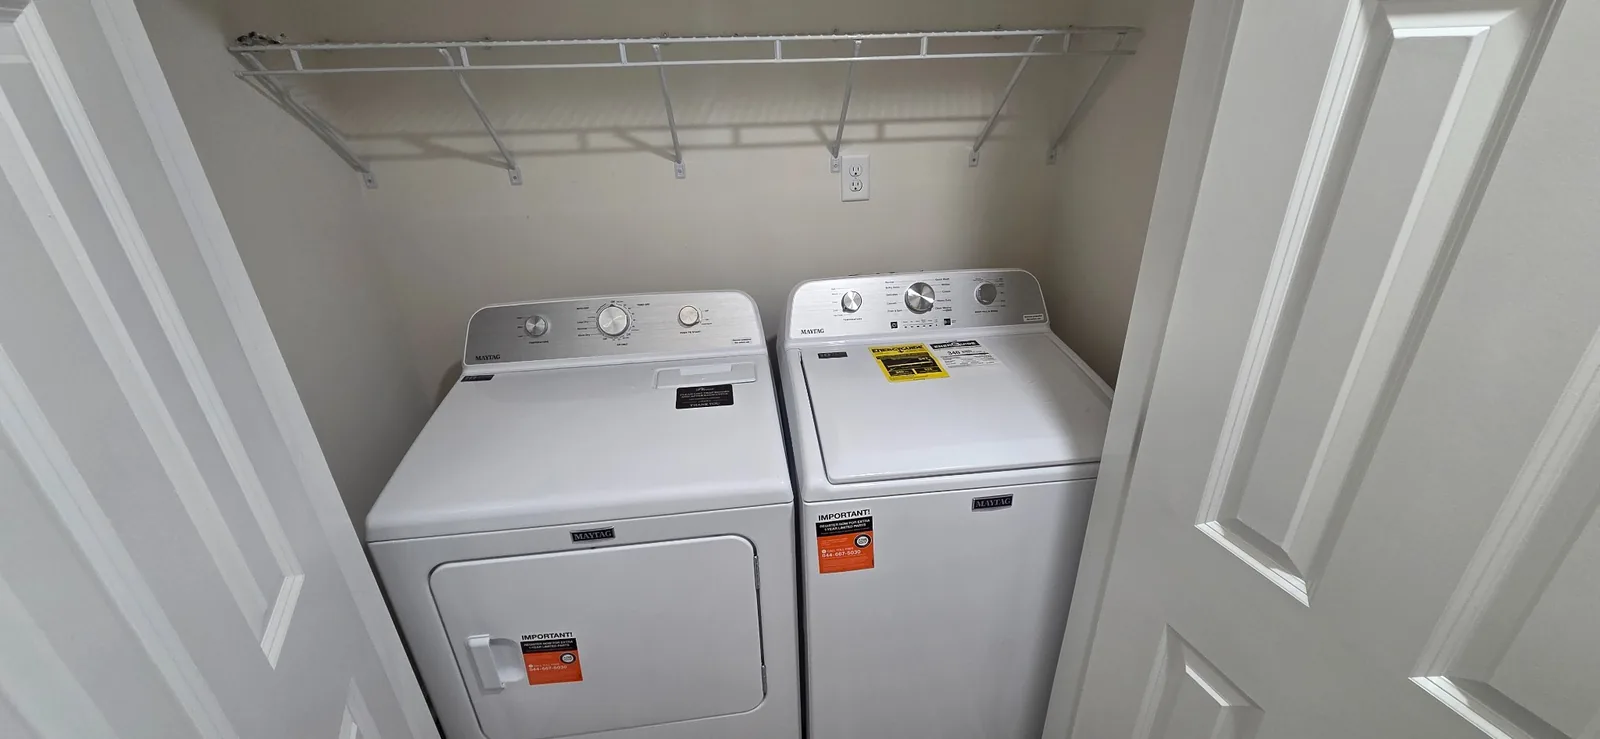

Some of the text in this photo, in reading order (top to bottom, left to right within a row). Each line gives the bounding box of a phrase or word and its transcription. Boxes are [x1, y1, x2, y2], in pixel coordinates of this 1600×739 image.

[976, 498, 1011, 508] MAYTAG
[818, 508, 870, 521] IMPORTANT!
[574, 530, 612, 540] MAYTAG
[522, 632, 573, 640] IMPORTANT!
